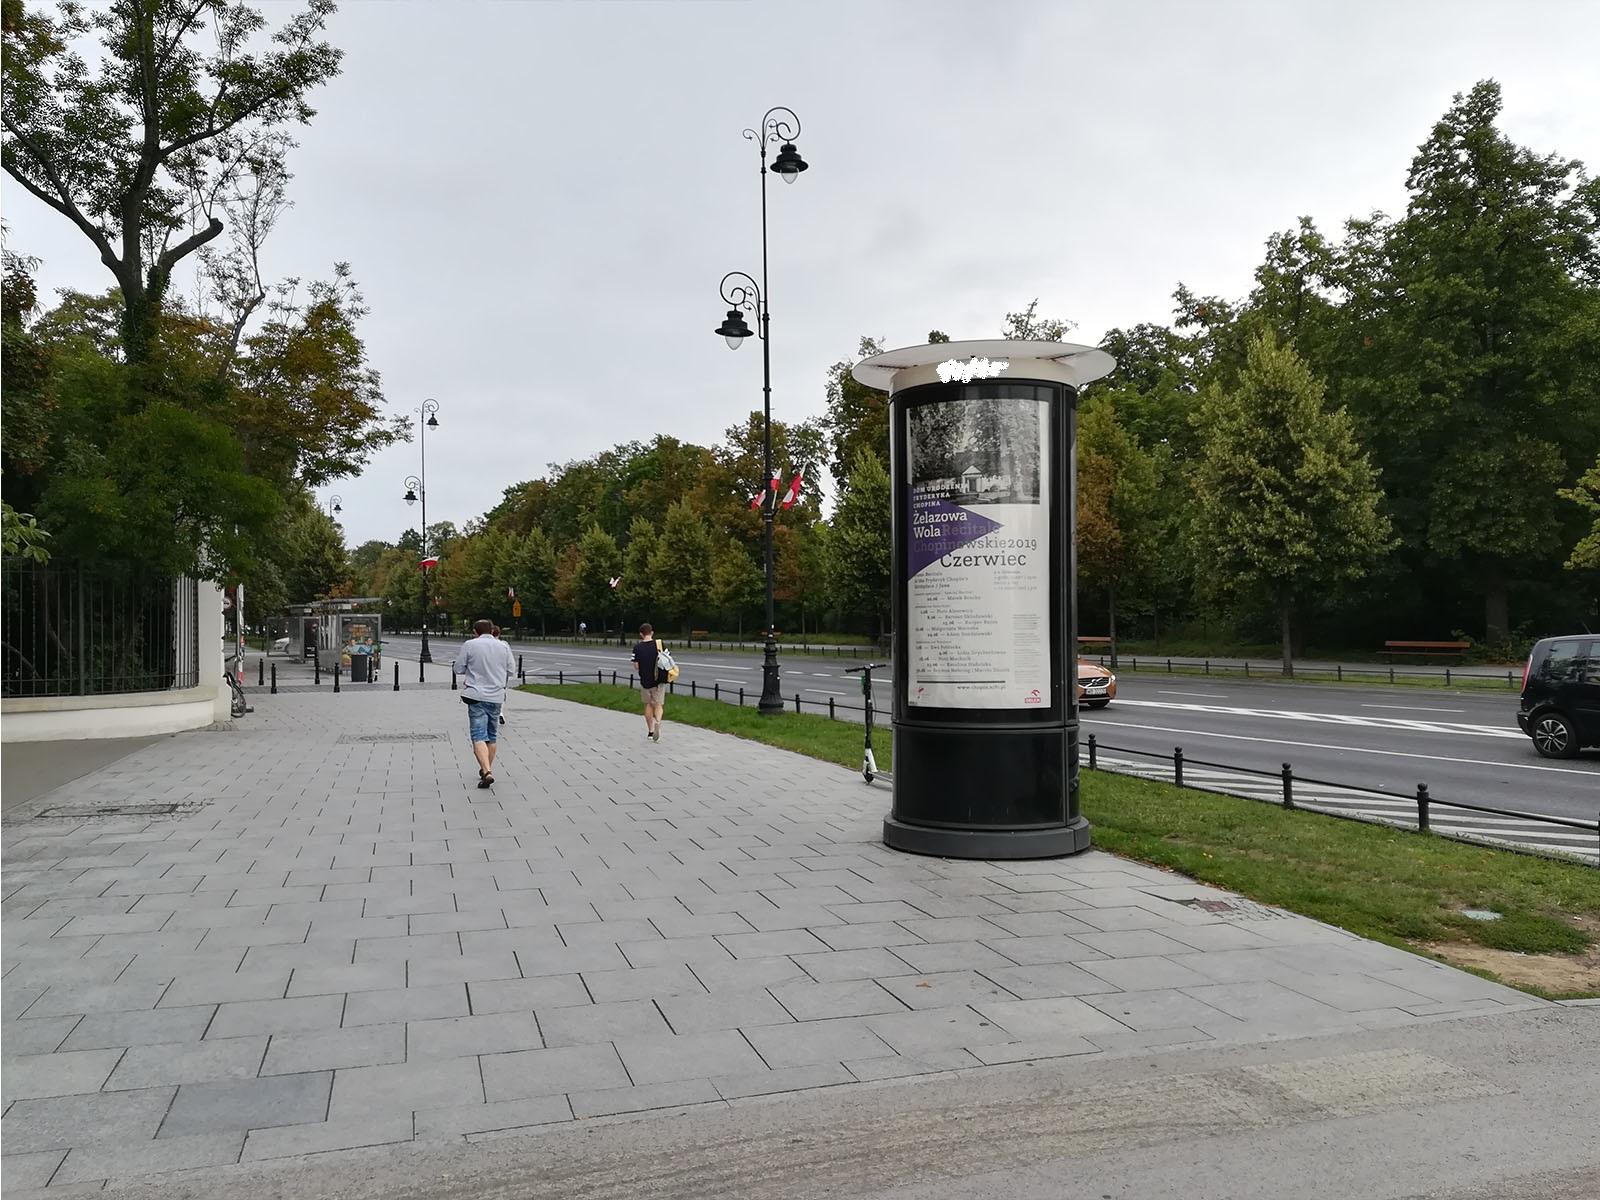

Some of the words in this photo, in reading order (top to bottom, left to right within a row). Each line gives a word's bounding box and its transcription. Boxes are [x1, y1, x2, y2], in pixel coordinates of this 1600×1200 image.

[913, 501, 941, 509] CHOPINA
[913, 510, 968, 525] Żelazowa
[913, 525, 941, 539] Wola
[1007, 538, 1037, 551] 2019
[940, 551, 1027, 568] Czerwiec
